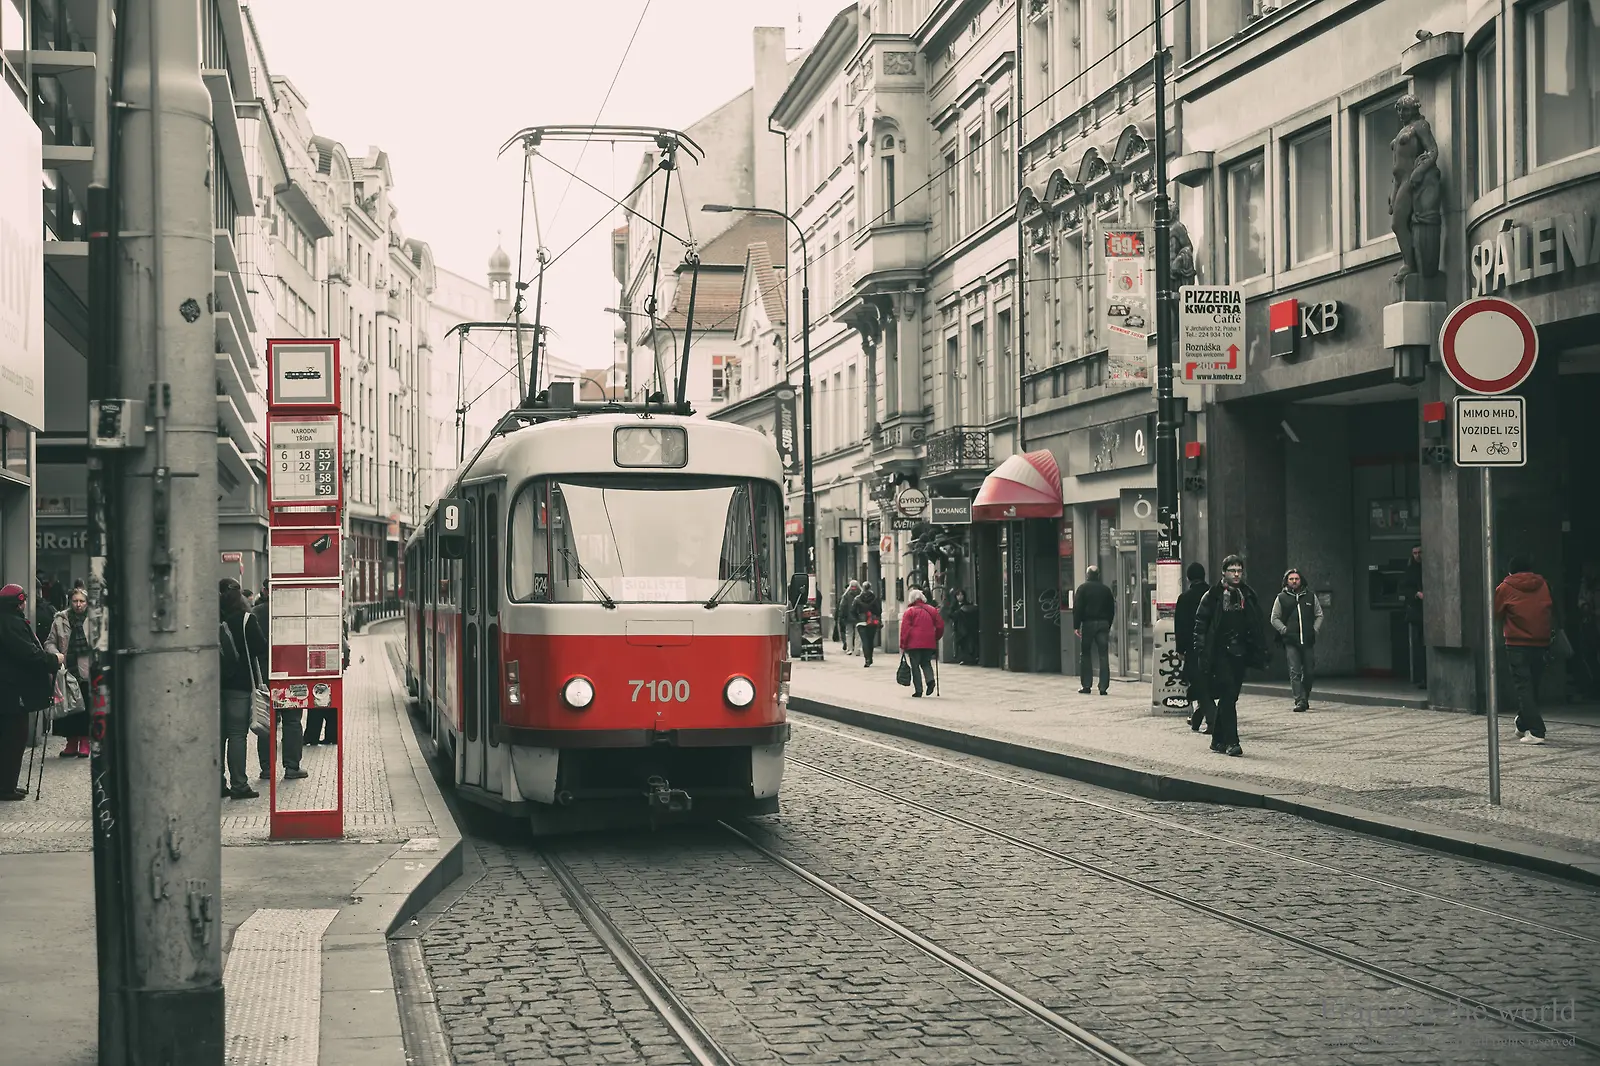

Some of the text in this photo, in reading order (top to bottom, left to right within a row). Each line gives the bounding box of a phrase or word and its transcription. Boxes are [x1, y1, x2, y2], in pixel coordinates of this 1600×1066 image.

[1471, 208, 1600, 299] SPÁLEN
[1185, 290, 1241, 304] PIZZERIA
[1185, 304, 1241, 314] KMOTRA
[1300, 300, 1338, 338] KB
[1185, 343, 1221, 351] Roznáška
[1463, 409, 1518, 419] MIMO MHD,
[781, 407, 793, 452] SUBWAY
[1461, 426, 1520, 435] VOZIDEL IZS
[1470, 444, 1478, 453] A
[281, 449, 331, 460] 6 18 53
[281, 461, 331, 472] 9 22 57
[299, 473, 332, 483] 91 58
[319, 485, 332, 495] 59
[934, 507, 967, 515] EXCHANGE
[445, 505, 459, 530] 9
[1014, 532, 1022, 574] EXCHANGE
[534, 576, 548, 593] 824
[628, 679, 690, 702] 7100
